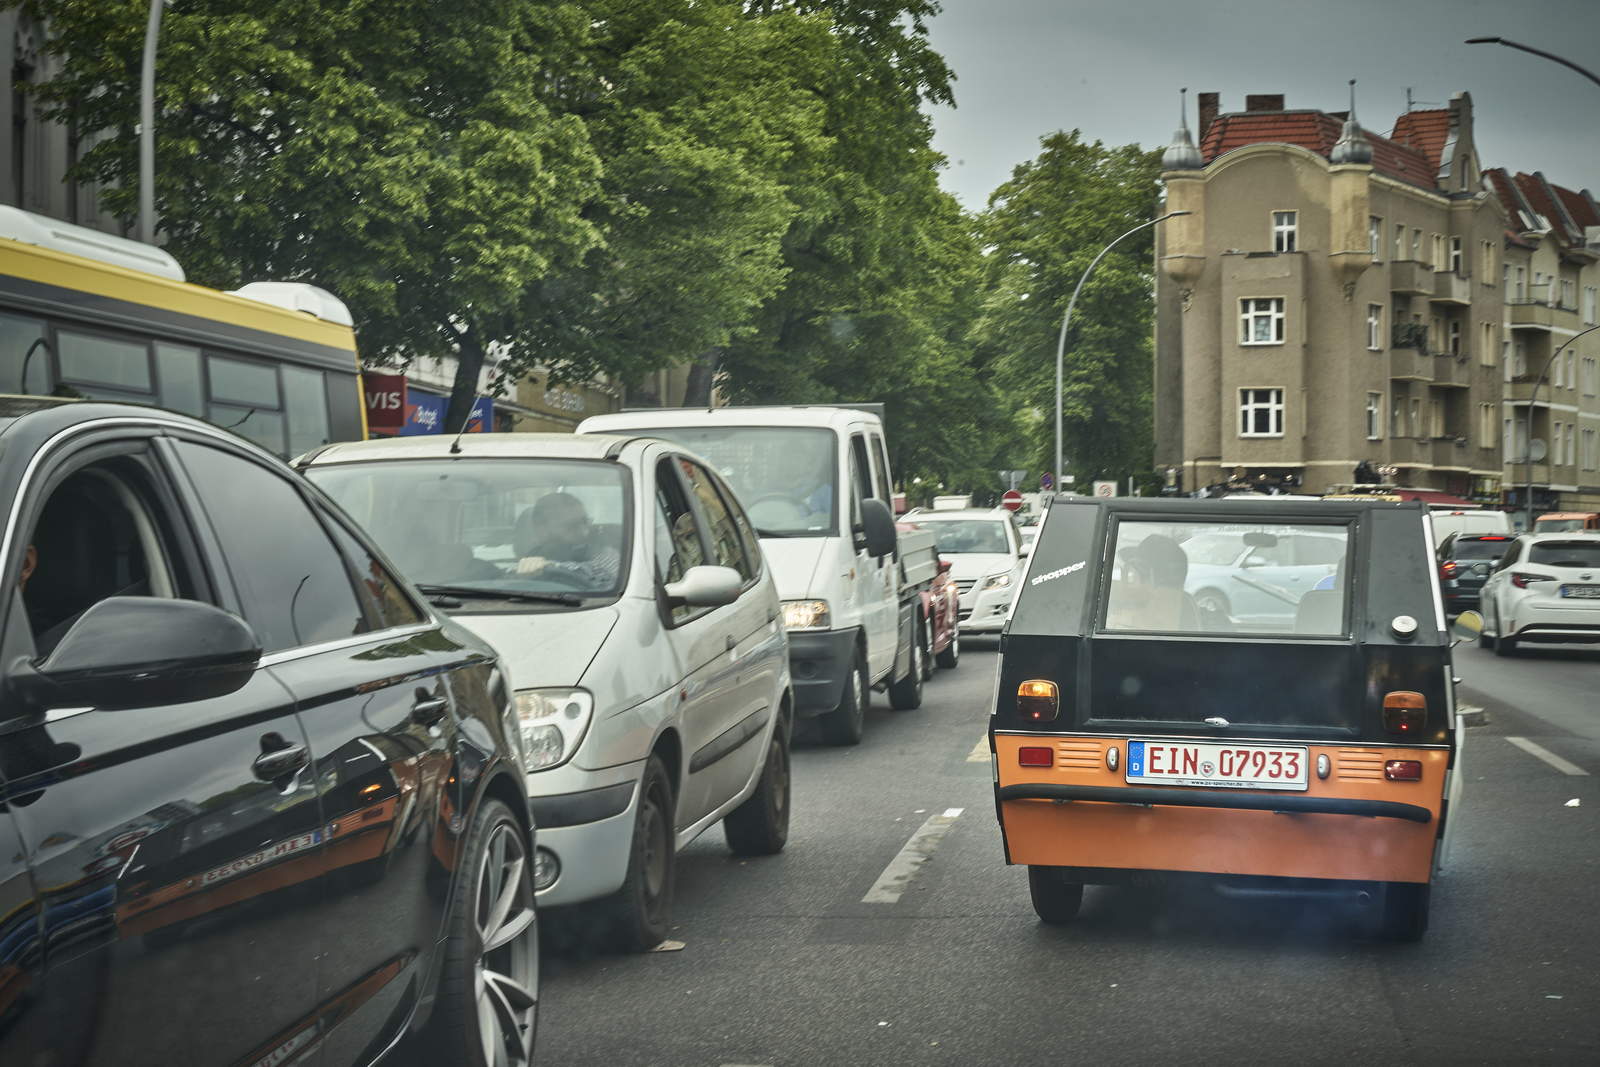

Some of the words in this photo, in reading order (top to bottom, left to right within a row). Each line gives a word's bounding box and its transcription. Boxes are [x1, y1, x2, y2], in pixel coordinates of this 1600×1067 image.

[367, 391, 402, 410] VIS
[1031, 560, 1086, 586] shopper
[1132, 762, 1140, 771] D
[1149, 746, 1198, 775] EIN
[1219, 749, 1300, 779] 07933
